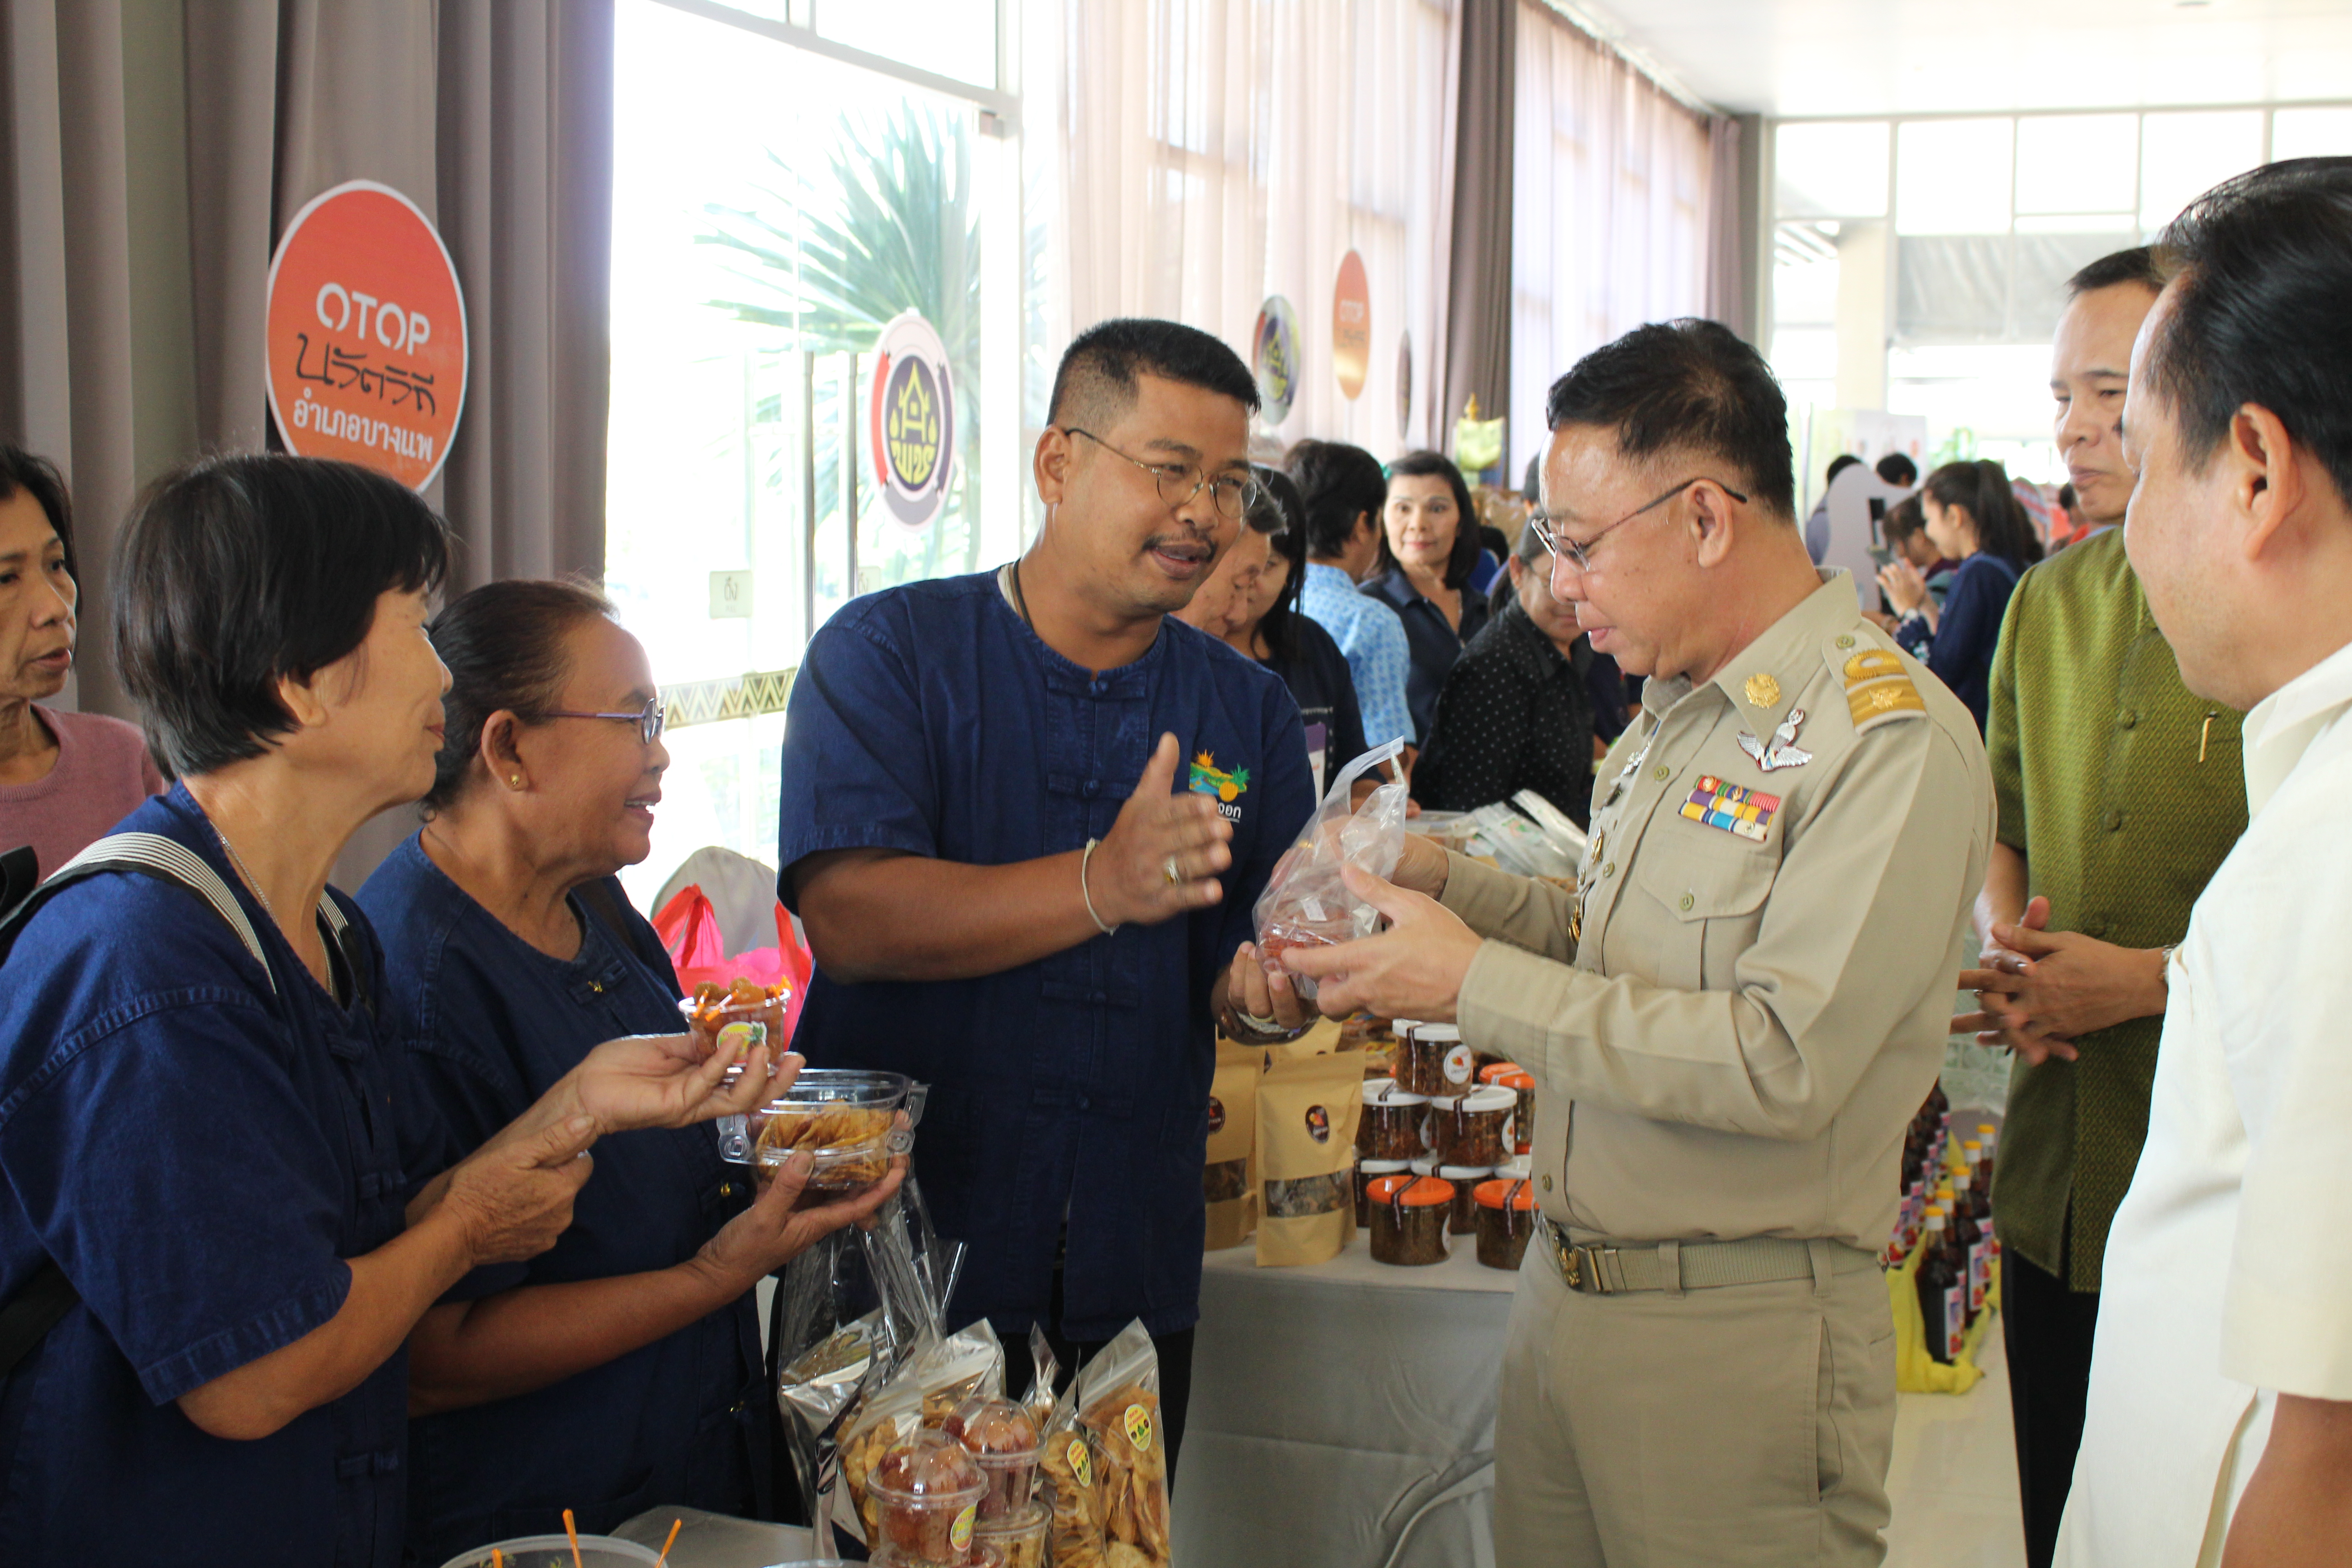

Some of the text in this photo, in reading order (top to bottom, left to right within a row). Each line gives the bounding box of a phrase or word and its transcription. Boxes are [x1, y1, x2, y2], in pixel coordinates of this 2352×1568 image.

[316, 282, 431, 355] OTOP
[293, 387, 433, 462] อำเภอบางแพ
